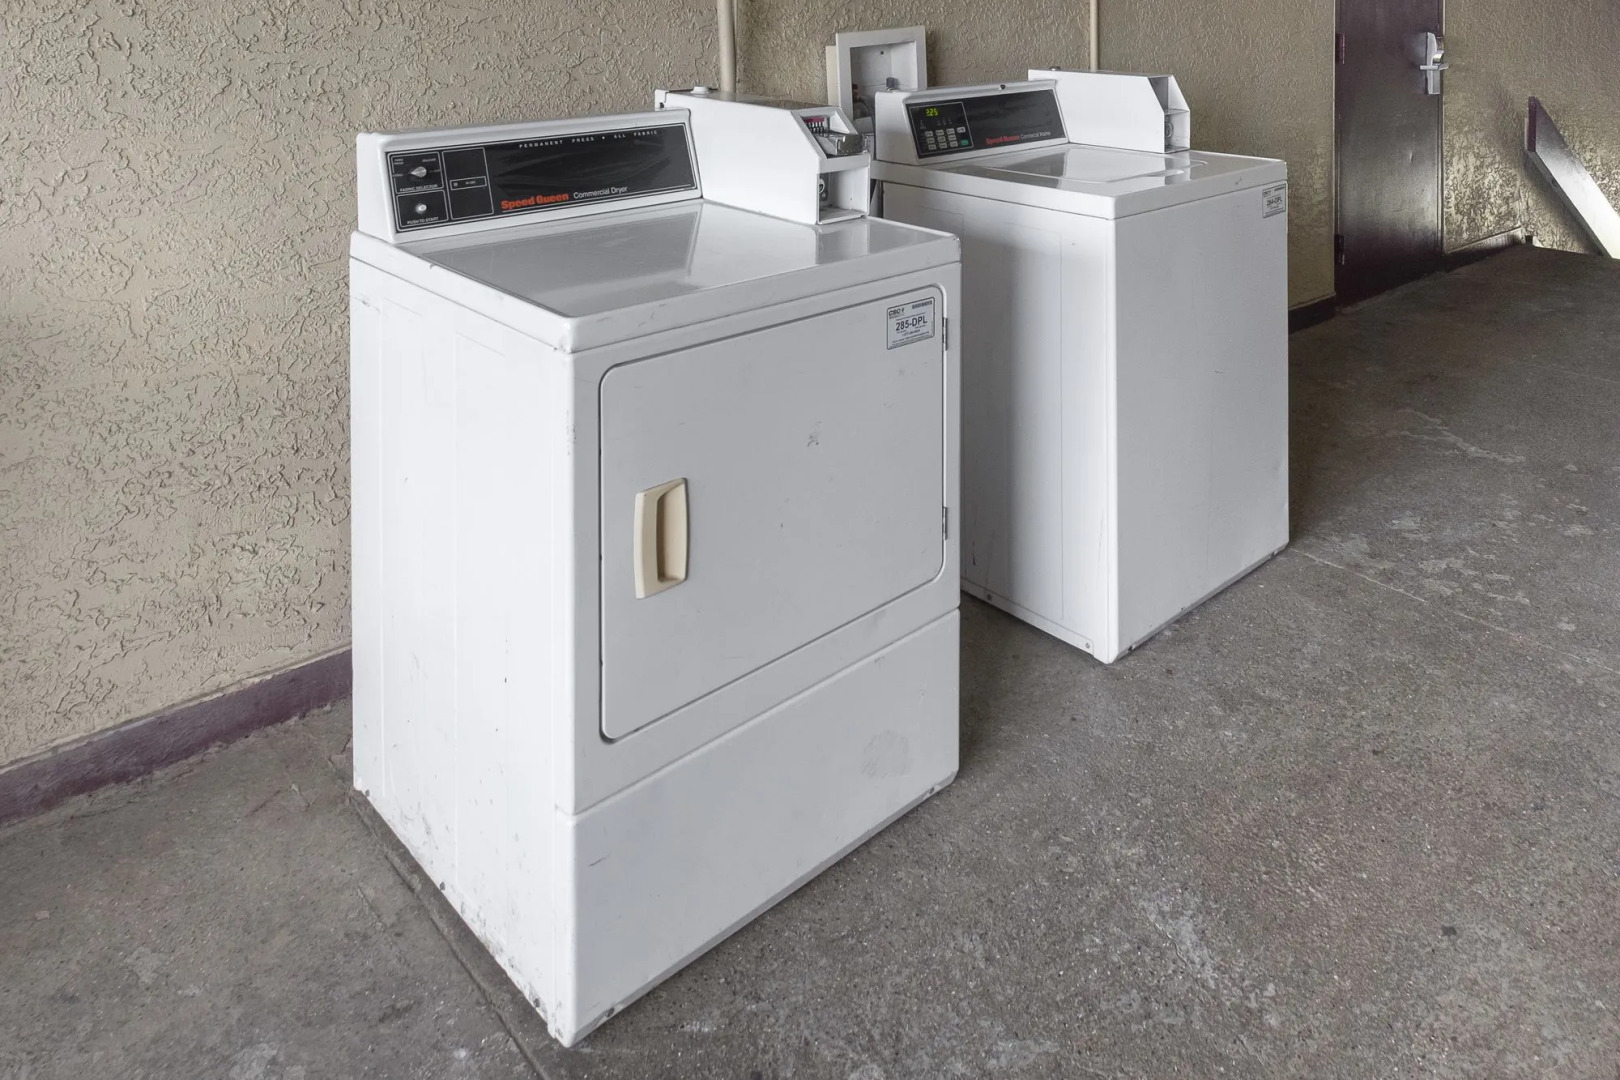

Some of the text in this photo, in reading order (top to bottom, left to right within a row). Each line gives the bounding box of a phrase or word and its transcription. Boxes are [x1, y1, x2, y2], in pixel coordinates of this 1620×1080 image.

[519, 139, 563, 148] PERMANENT
[633, 129, 658, 137] FABRIC
[501, 184, 628, 210] Speed Queen Commercial Dryer
[896, 316, 927, 331] 285-DPL
